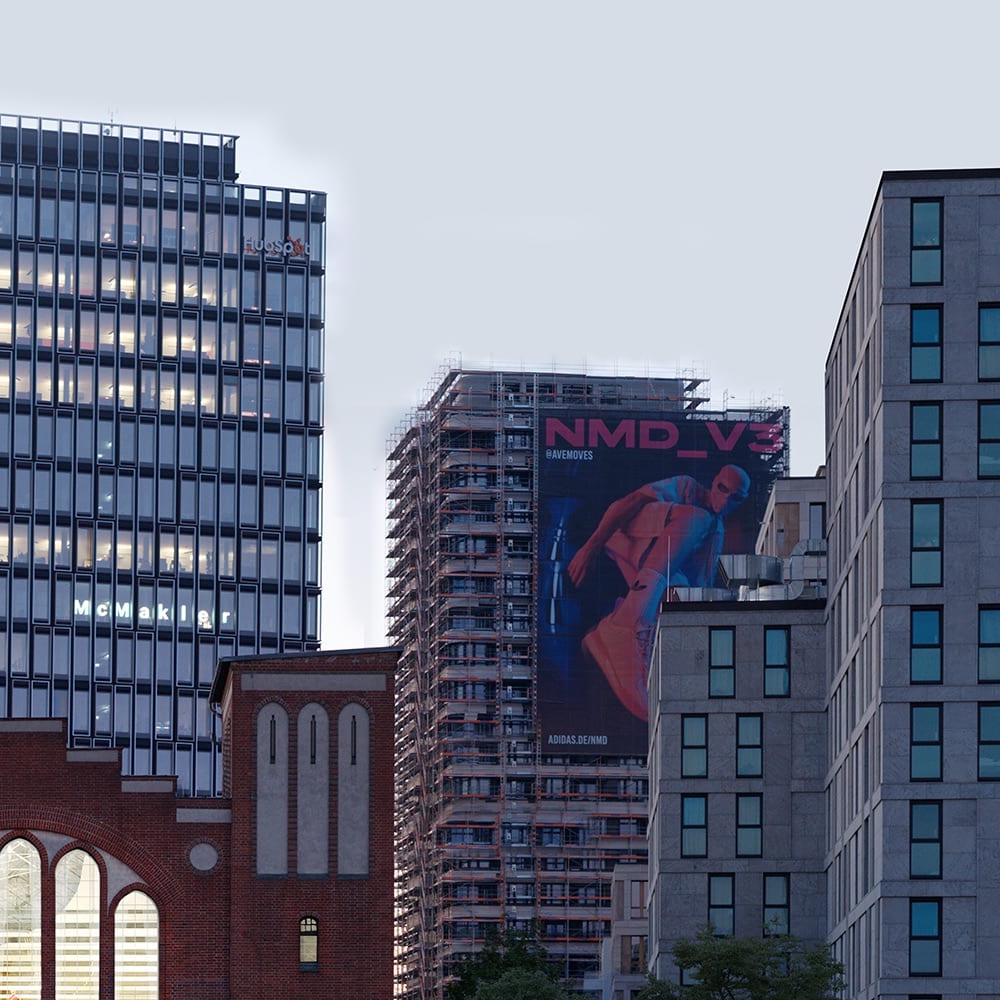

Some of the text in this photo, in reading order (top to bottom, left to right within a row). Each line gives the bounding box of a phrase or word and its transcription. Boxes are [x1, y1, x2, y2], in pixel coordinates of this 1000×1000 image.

[545, 417, 783, 459] NMD_V3
[545, 448, 594, 461] @AVEMOVES
[74, 599, 231, 626] McMakler
[547, 734, 609, 746] ADIDAS.DE/NMD
